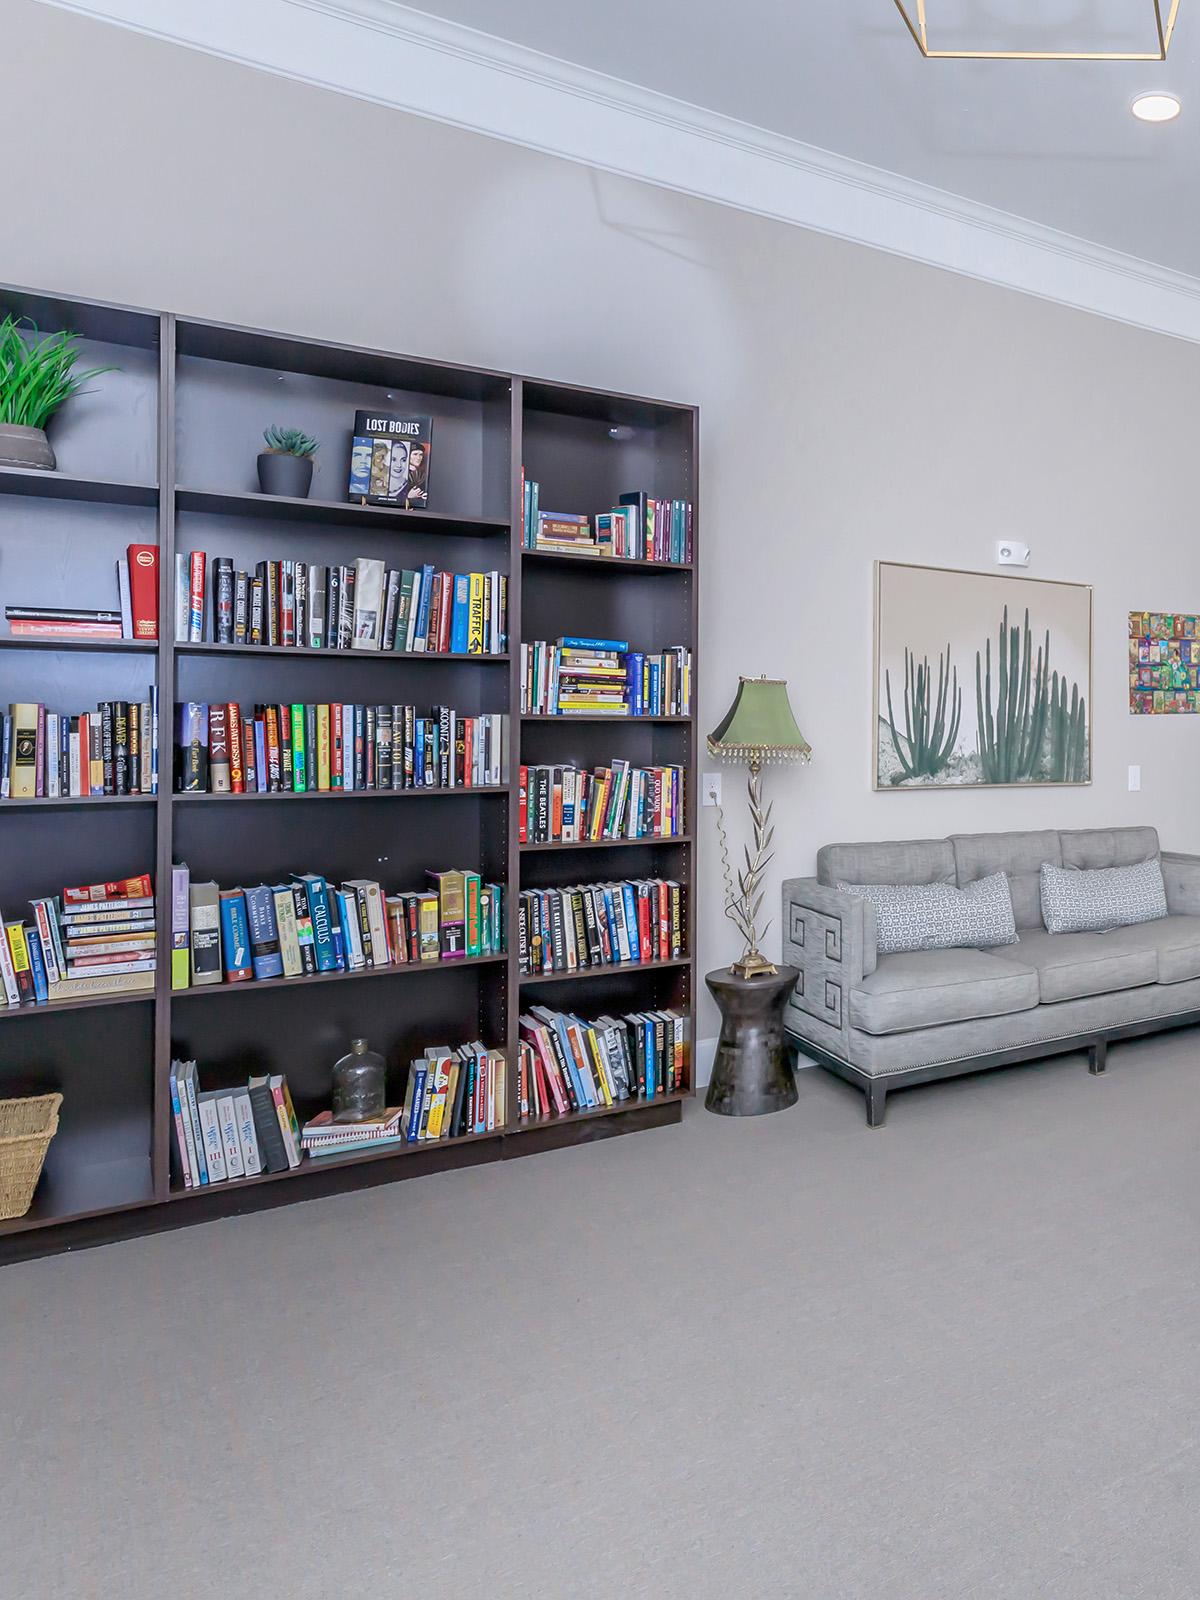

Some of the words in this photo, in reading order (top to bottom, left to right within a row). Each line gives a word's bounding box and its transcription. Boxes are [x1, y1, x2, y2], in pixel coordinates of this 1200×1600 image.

[366, 418, 388, 432] LOST
[389, 421, 420, 435] BODIES
[237, 580, 245, 599] MICHAEL
[252, 586, 262, 606] MICHAEL
[237, 600, 245, 623] CONNELLY
[253, 607, 262, 629] CONNELLY
[472, 598, 482, 635] TRAFFIC
[229, 706, 238, 728] JAMES
[440, 710, 449, 742] KOONTZ
[115, 717, 127, 744] DEAVER
[393, 721, 401, 745] LAW
[230, 728, 240, 768] PATTERSON
[393, 748, 401, 765] 101
[283, 749, 291, 772] PRIVATE
[294, 892, 303, 917] BROKAW
[571, 895, 582, 911] ICON
[672, 888, 680, 904] DAVID
[250, 895, 260, 939] COMMENTARY
[584, 892, 595, 928] BERNSTEIN
[672, 904, 680, 930] BALDACCI
[314, 904, 330, 944] CALCULUS
[554, 928, 562, 956] ATKINSON
